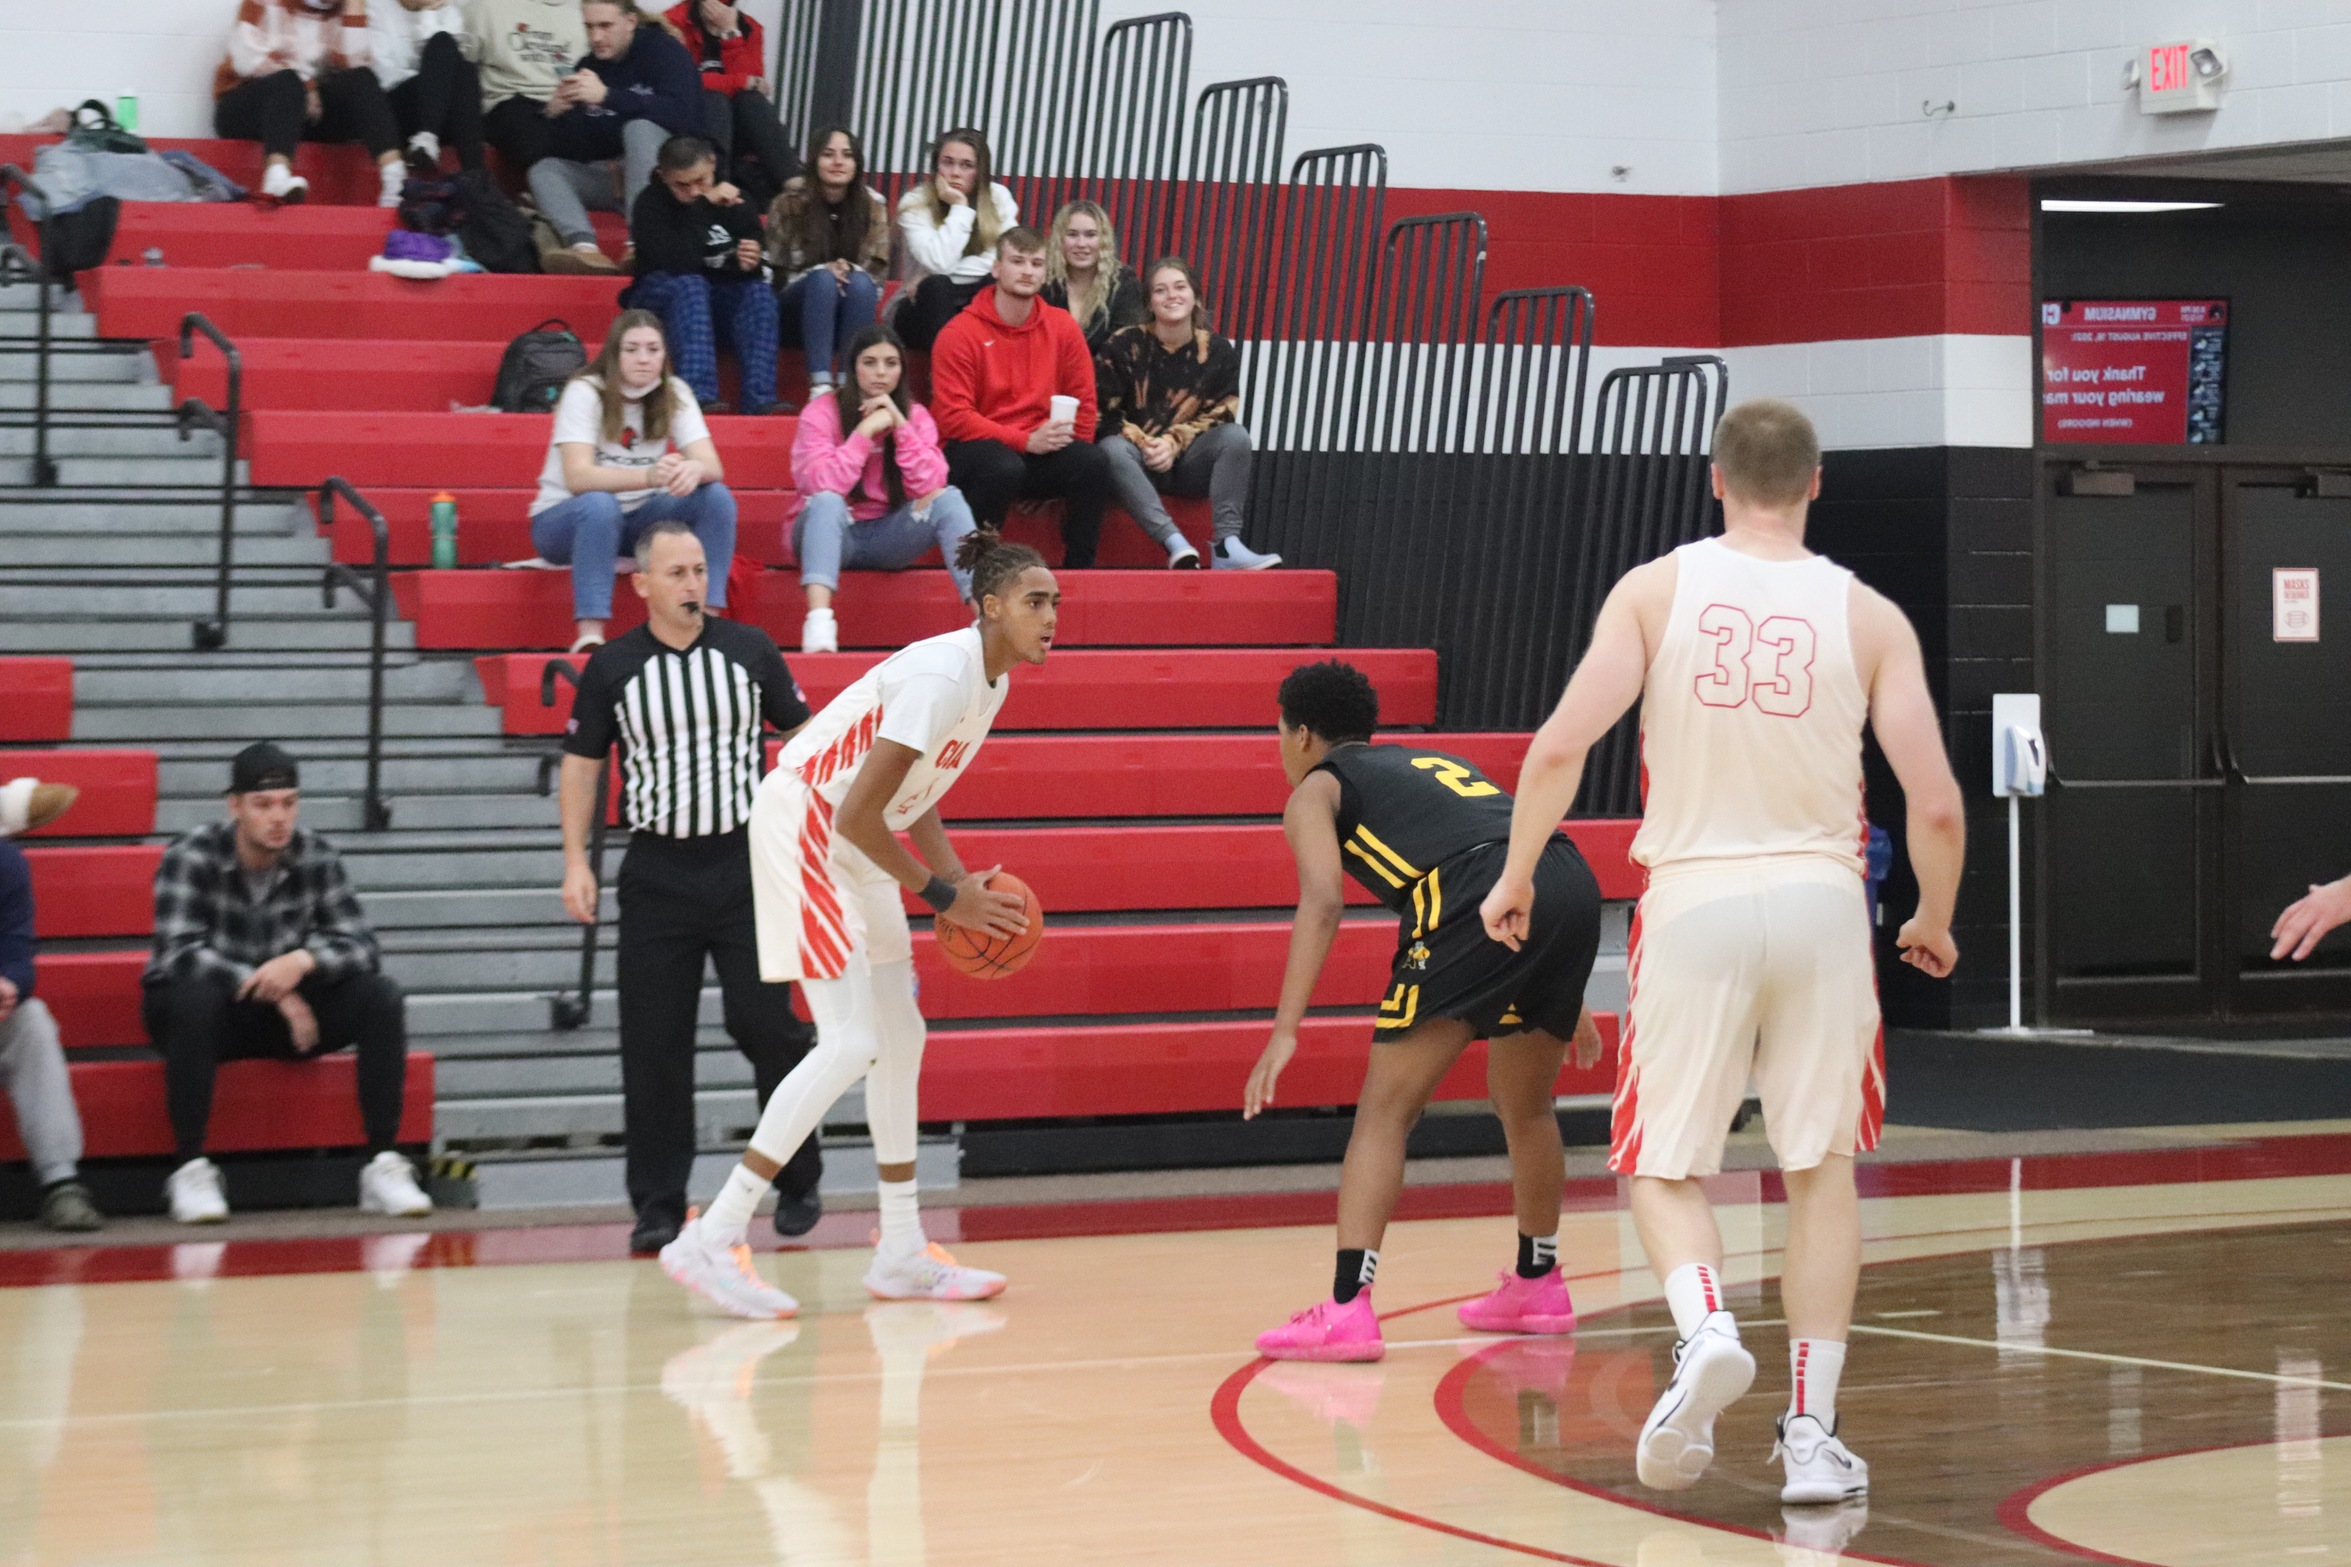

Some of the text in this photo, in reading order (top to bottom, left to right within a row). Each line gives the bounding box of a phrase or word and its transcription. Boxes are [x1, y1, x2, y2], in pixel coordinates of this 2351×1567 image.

[2150, 44, 2189, 92] EXIT
[2283, 578, 2309, 590] MASKS
[1694, 603, 1816, 718] 33
[1410, 757, 1501, 797] 2
